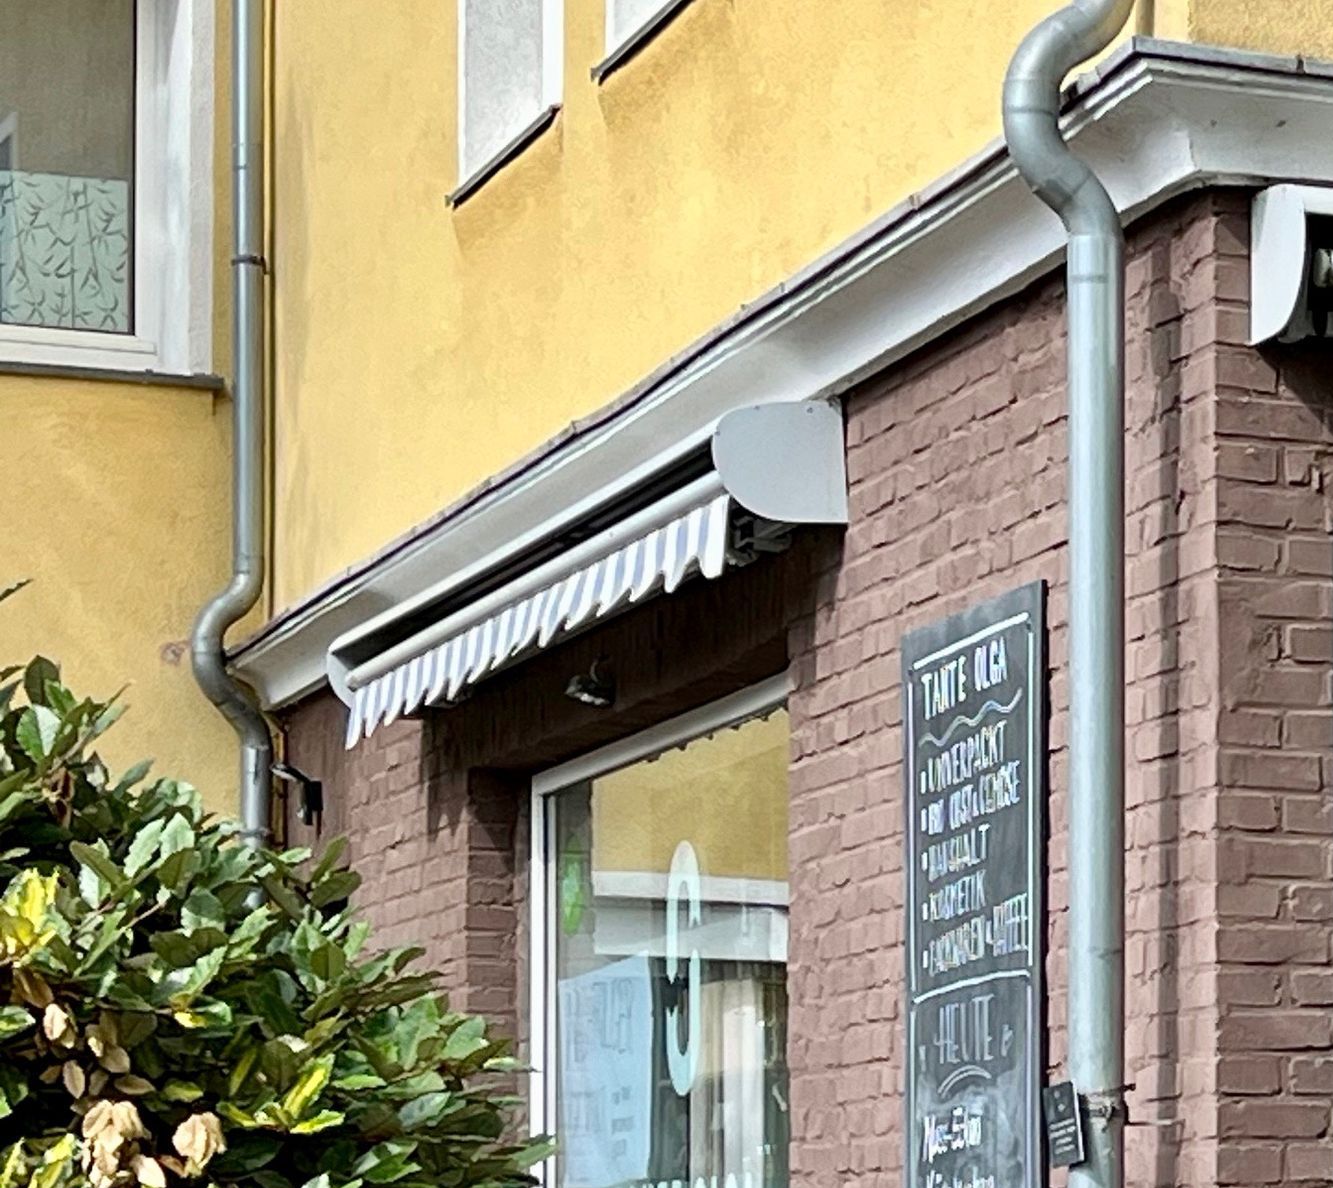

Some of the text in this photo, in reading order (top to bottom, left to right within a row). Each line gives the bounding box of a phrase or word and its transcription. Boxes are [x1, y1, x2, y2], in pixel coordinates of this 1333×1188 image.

[920, 636, 1007, 720] TANTE OLGA
[934, 993, 995, 1065] HEUTE
